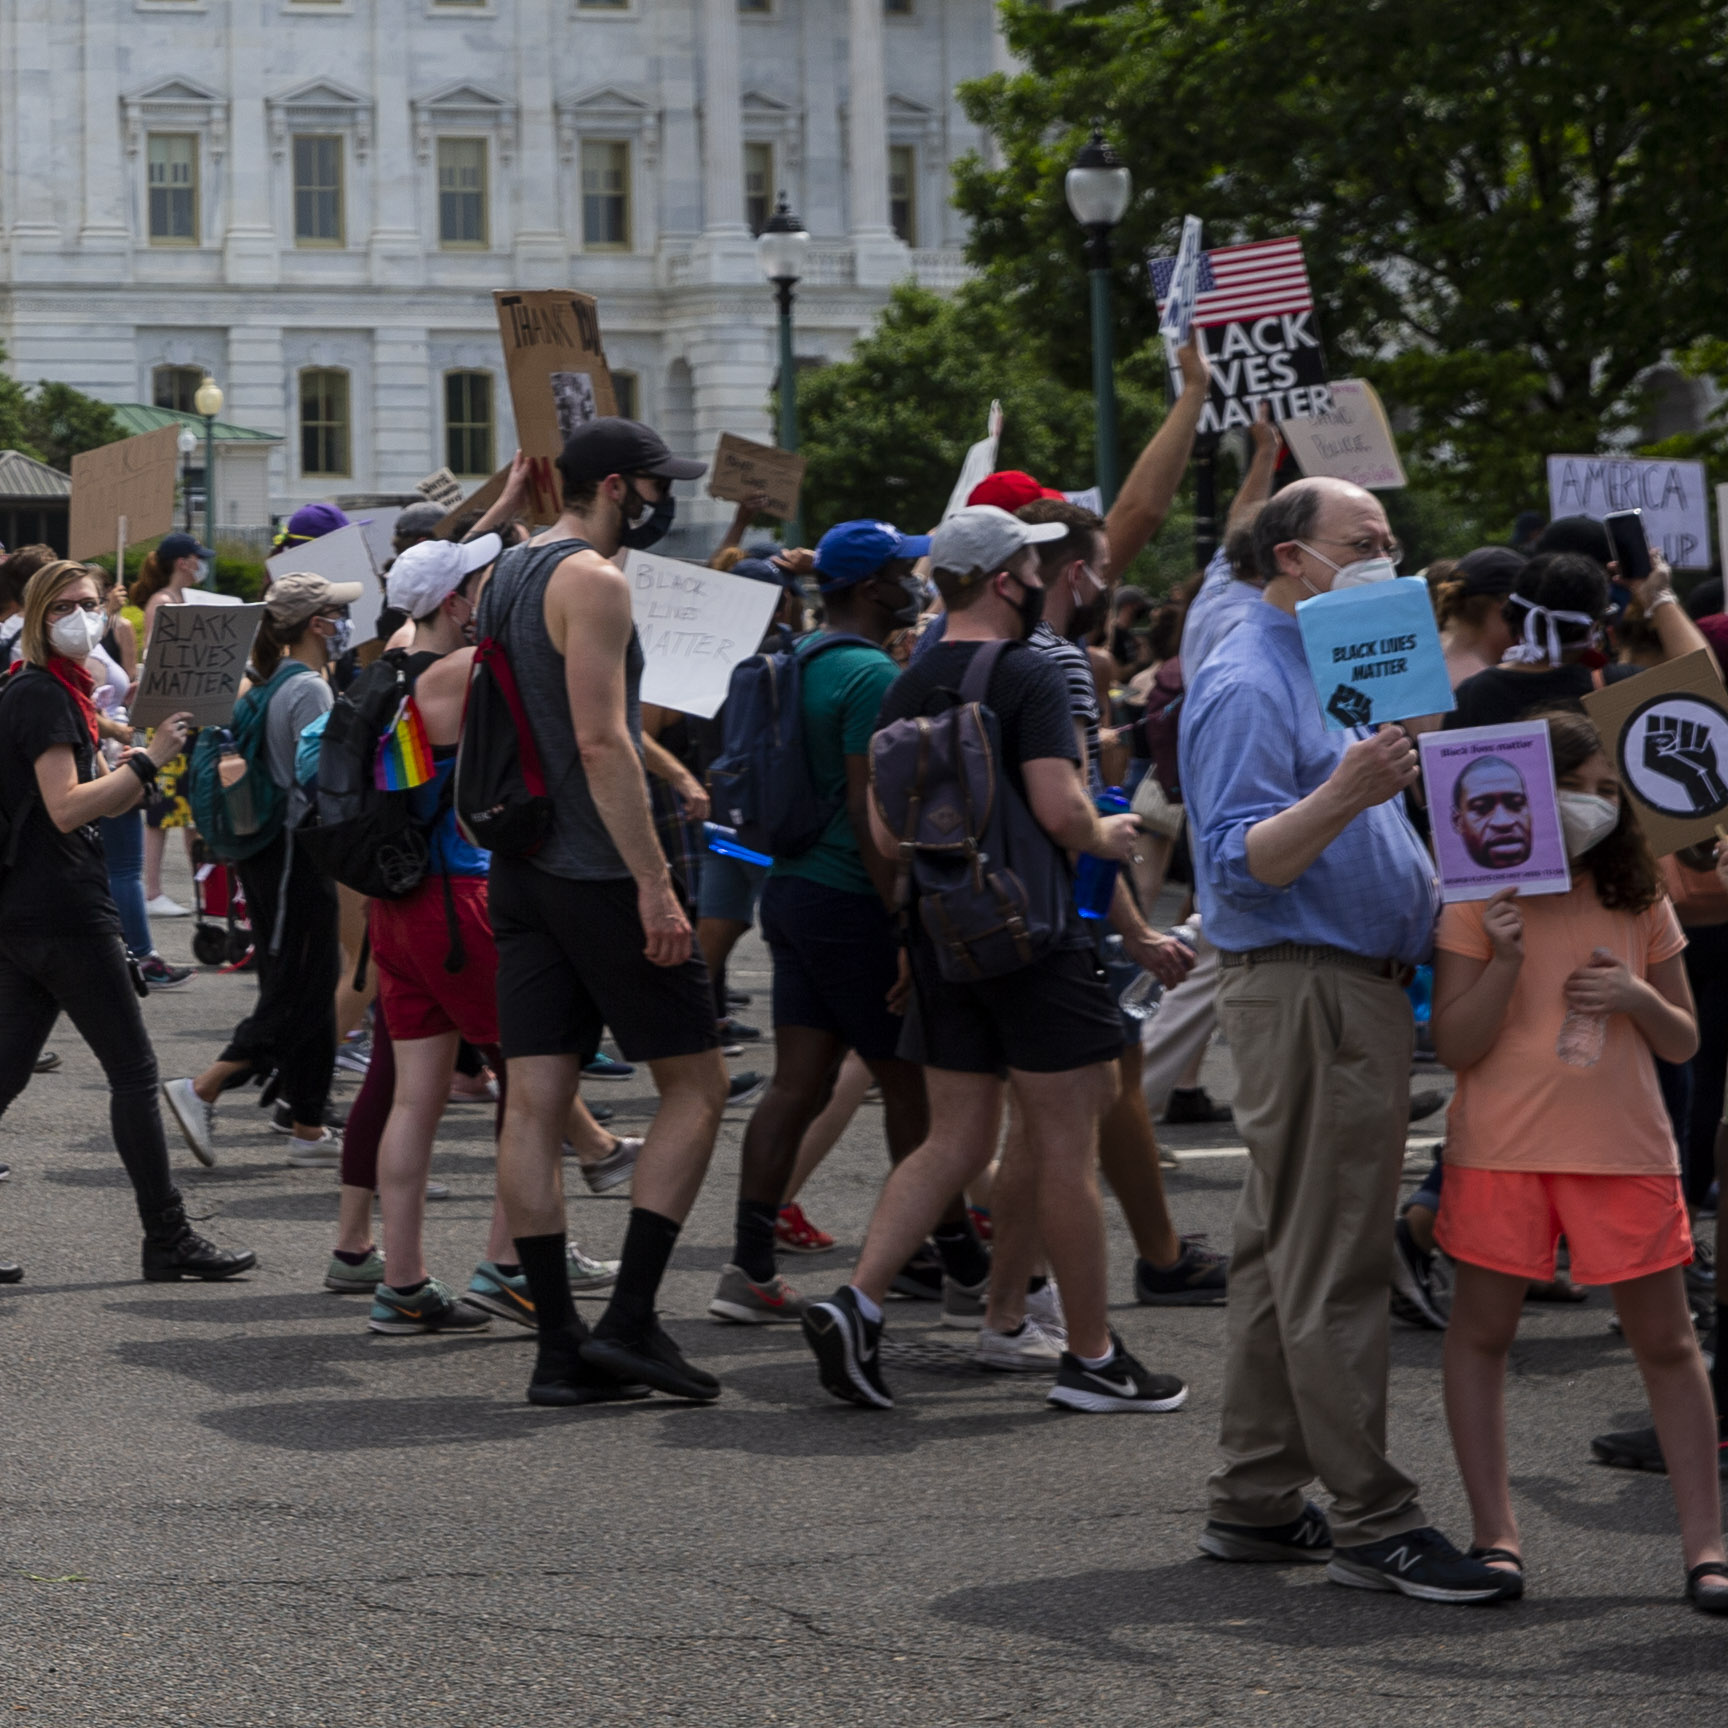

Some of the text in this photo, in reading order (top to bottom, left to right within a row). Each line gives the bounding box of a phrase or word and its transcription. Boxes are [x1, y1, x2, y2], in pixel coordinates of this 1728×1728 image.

[500, 295, 575, 349] THANK
[1194, 312, 1320, 363] LACK
[1197, 384, 1336, 434] MATTER
[1558, 459, 1689, 512] AMERICA
[635, 563, 710, 598] BLACK
[155, 611, 239, 644] BLACK
[159, 642, 241, 669] LIVES
[1332, 633, 1418, 664] BLACK LIVES
[145, 669, 236, 697] MATTER
[1350, 657, 1409, 682] MATTER
